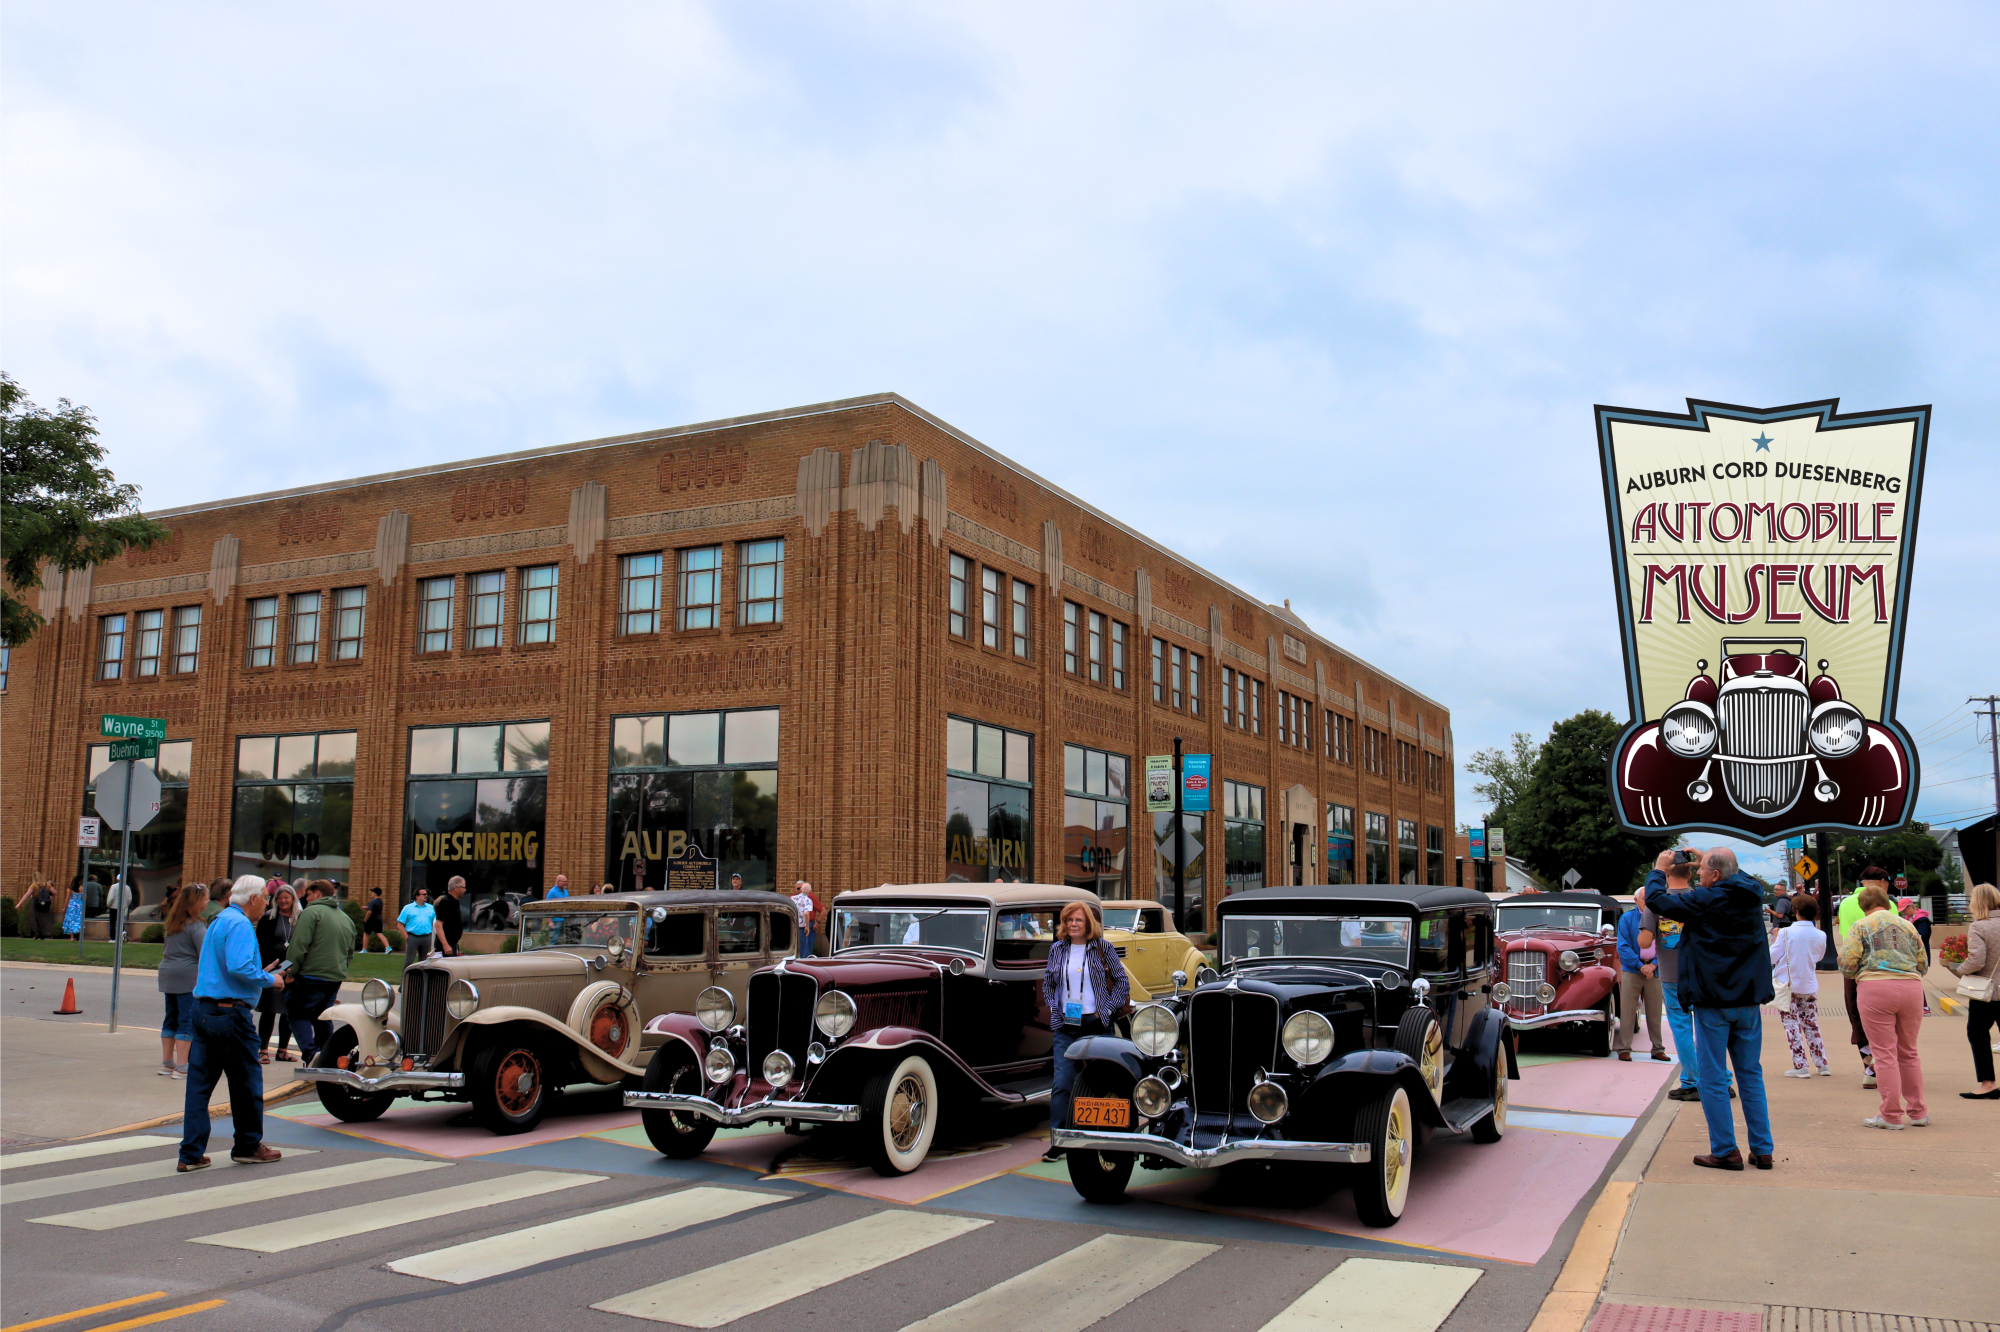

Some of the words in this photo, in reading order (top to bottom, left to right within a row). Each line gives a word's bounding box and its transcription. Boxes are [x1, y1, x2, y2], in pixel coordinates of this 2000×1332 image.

[104, 717, 145, 737] Wayne
[150, 720, 158, 728] St
[261, 832, 320, 860] CORD
[414, 830, 539, 861] DUESENBERG
[619, 829, 767, 861] AUBURN
[950, 834, 1026, 868] AUBURN
[1081, 845, 1112, 873] CORD
[1077, 1107, 1100, 1123] 227
[1103, 1108, 1126, 1124] 437
